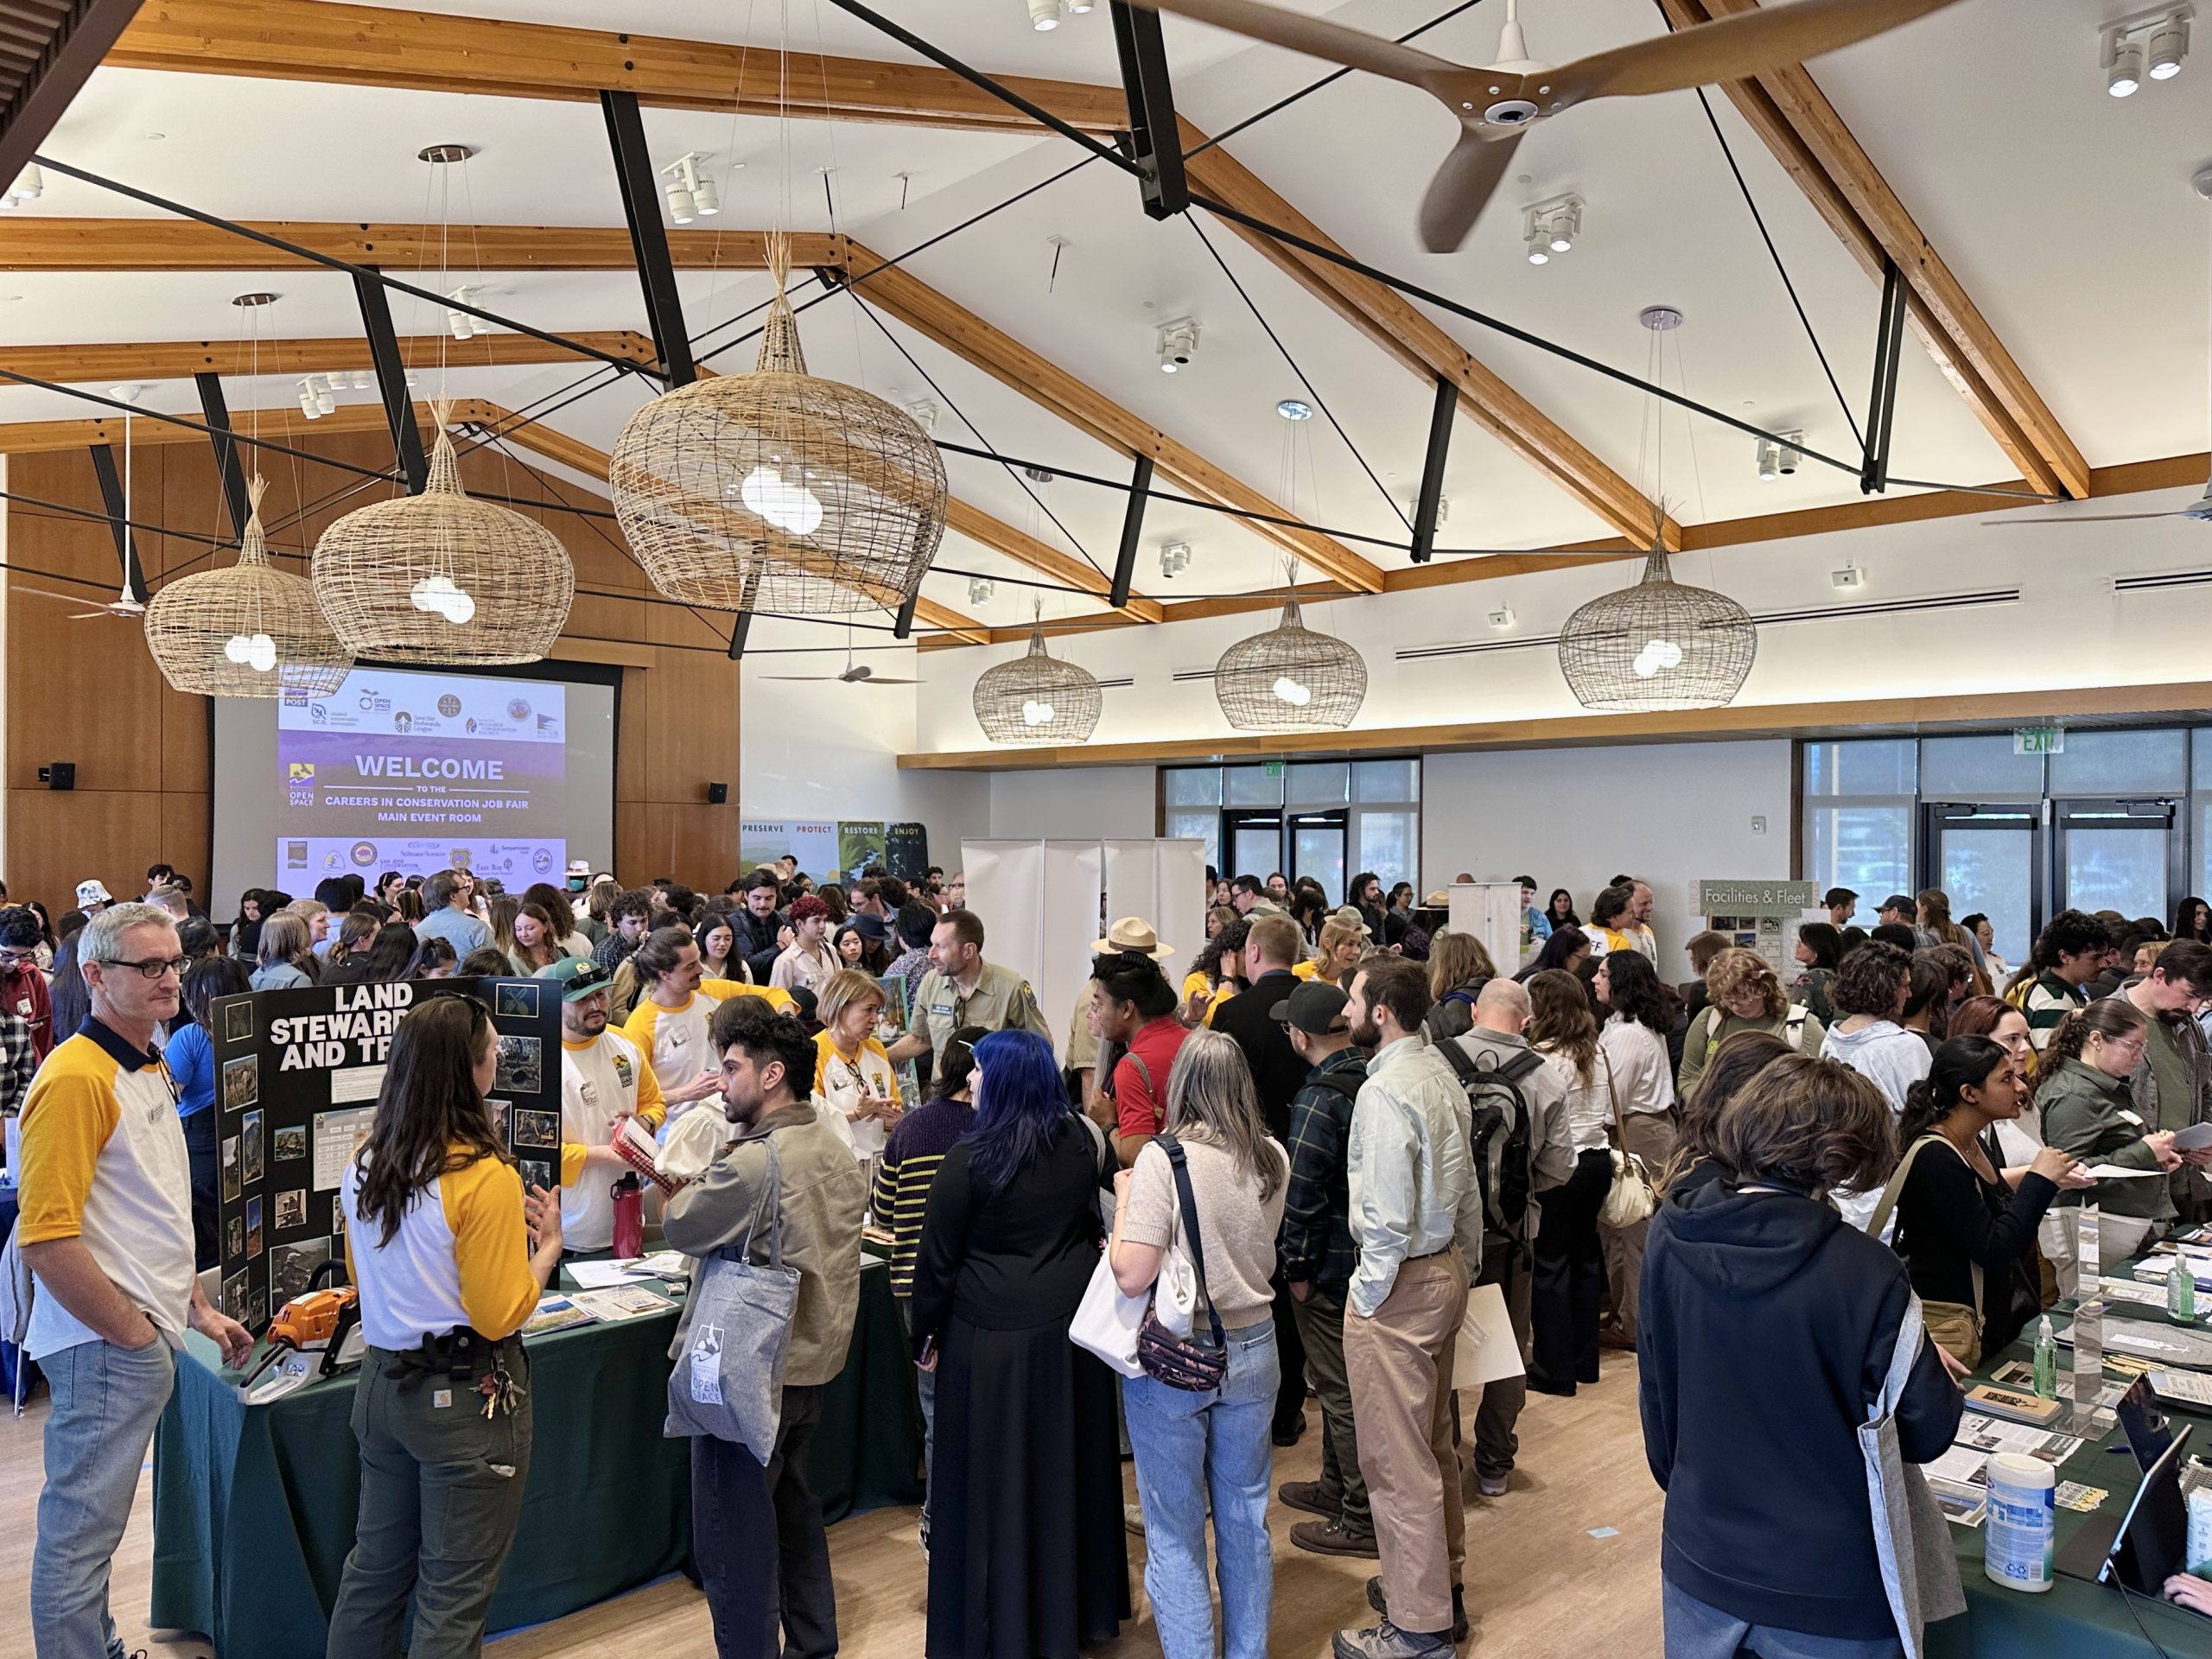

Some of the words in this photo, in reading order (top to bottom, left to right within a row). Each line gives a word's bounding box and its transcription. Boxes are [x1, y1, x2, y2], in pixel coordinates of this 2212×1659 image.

[2023, 730, 2056, 752] EXIT
[355, 754, 504, 780] WELCOME
[325, 796, 378, 806] CAREERS
[381, 798, 393, 807] IN
[396, 798, 480, 808] CONSERVATION
[481, 800, 504, 809] JOB
[505, 800, 529, 809] FAIR
[378, 812, 407, 822] MAIN
[410, 813, 447, 822] EVENT
[448, 814, 481, 823] ROOM
[742, 824, 785, 833] PRESERVE
[797, 825, 832, 834] PROTECT
[844, 826, 879, 835] RESTORE
[491, 863, 502, 872] Bay
[1706, 887, 1758, 904] Facilities
[1763, 889, 1773, 904] &
[1777, 890, 1806, 905] Fleet
[335, 982, 413, 1013] LAND
[279, 1040, 346, 1071] AND
[693, 1376, 719, 1392] OPEN
[692, 1389, 721, 1402] SPACE
